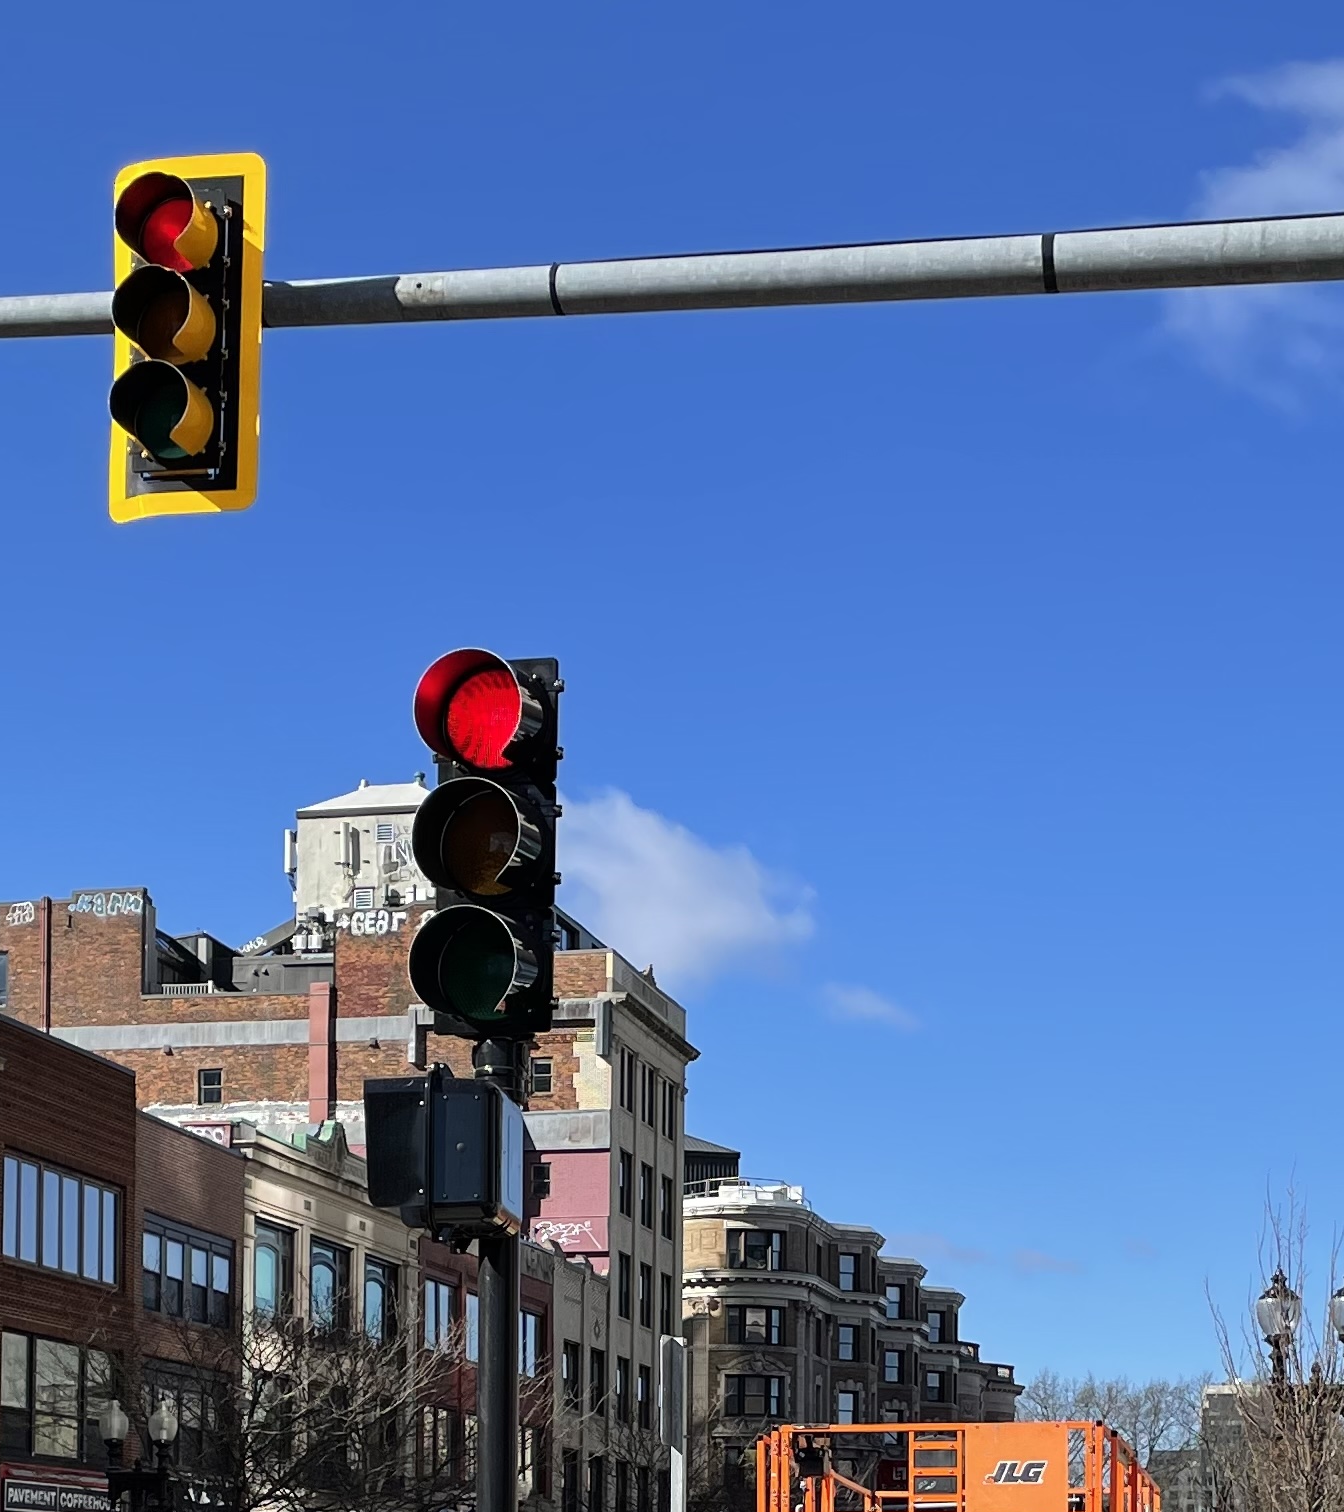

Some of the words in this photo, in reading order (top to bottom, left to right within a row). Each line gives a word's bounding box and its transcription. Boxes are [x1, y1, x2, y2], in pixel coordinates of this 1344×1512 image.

[984, 1461, 1048, 1485] JLG
[7, 1487, 57, 1507] PAVEMENT
[59, 1492, 121, 1512] COFFEEHOUE
